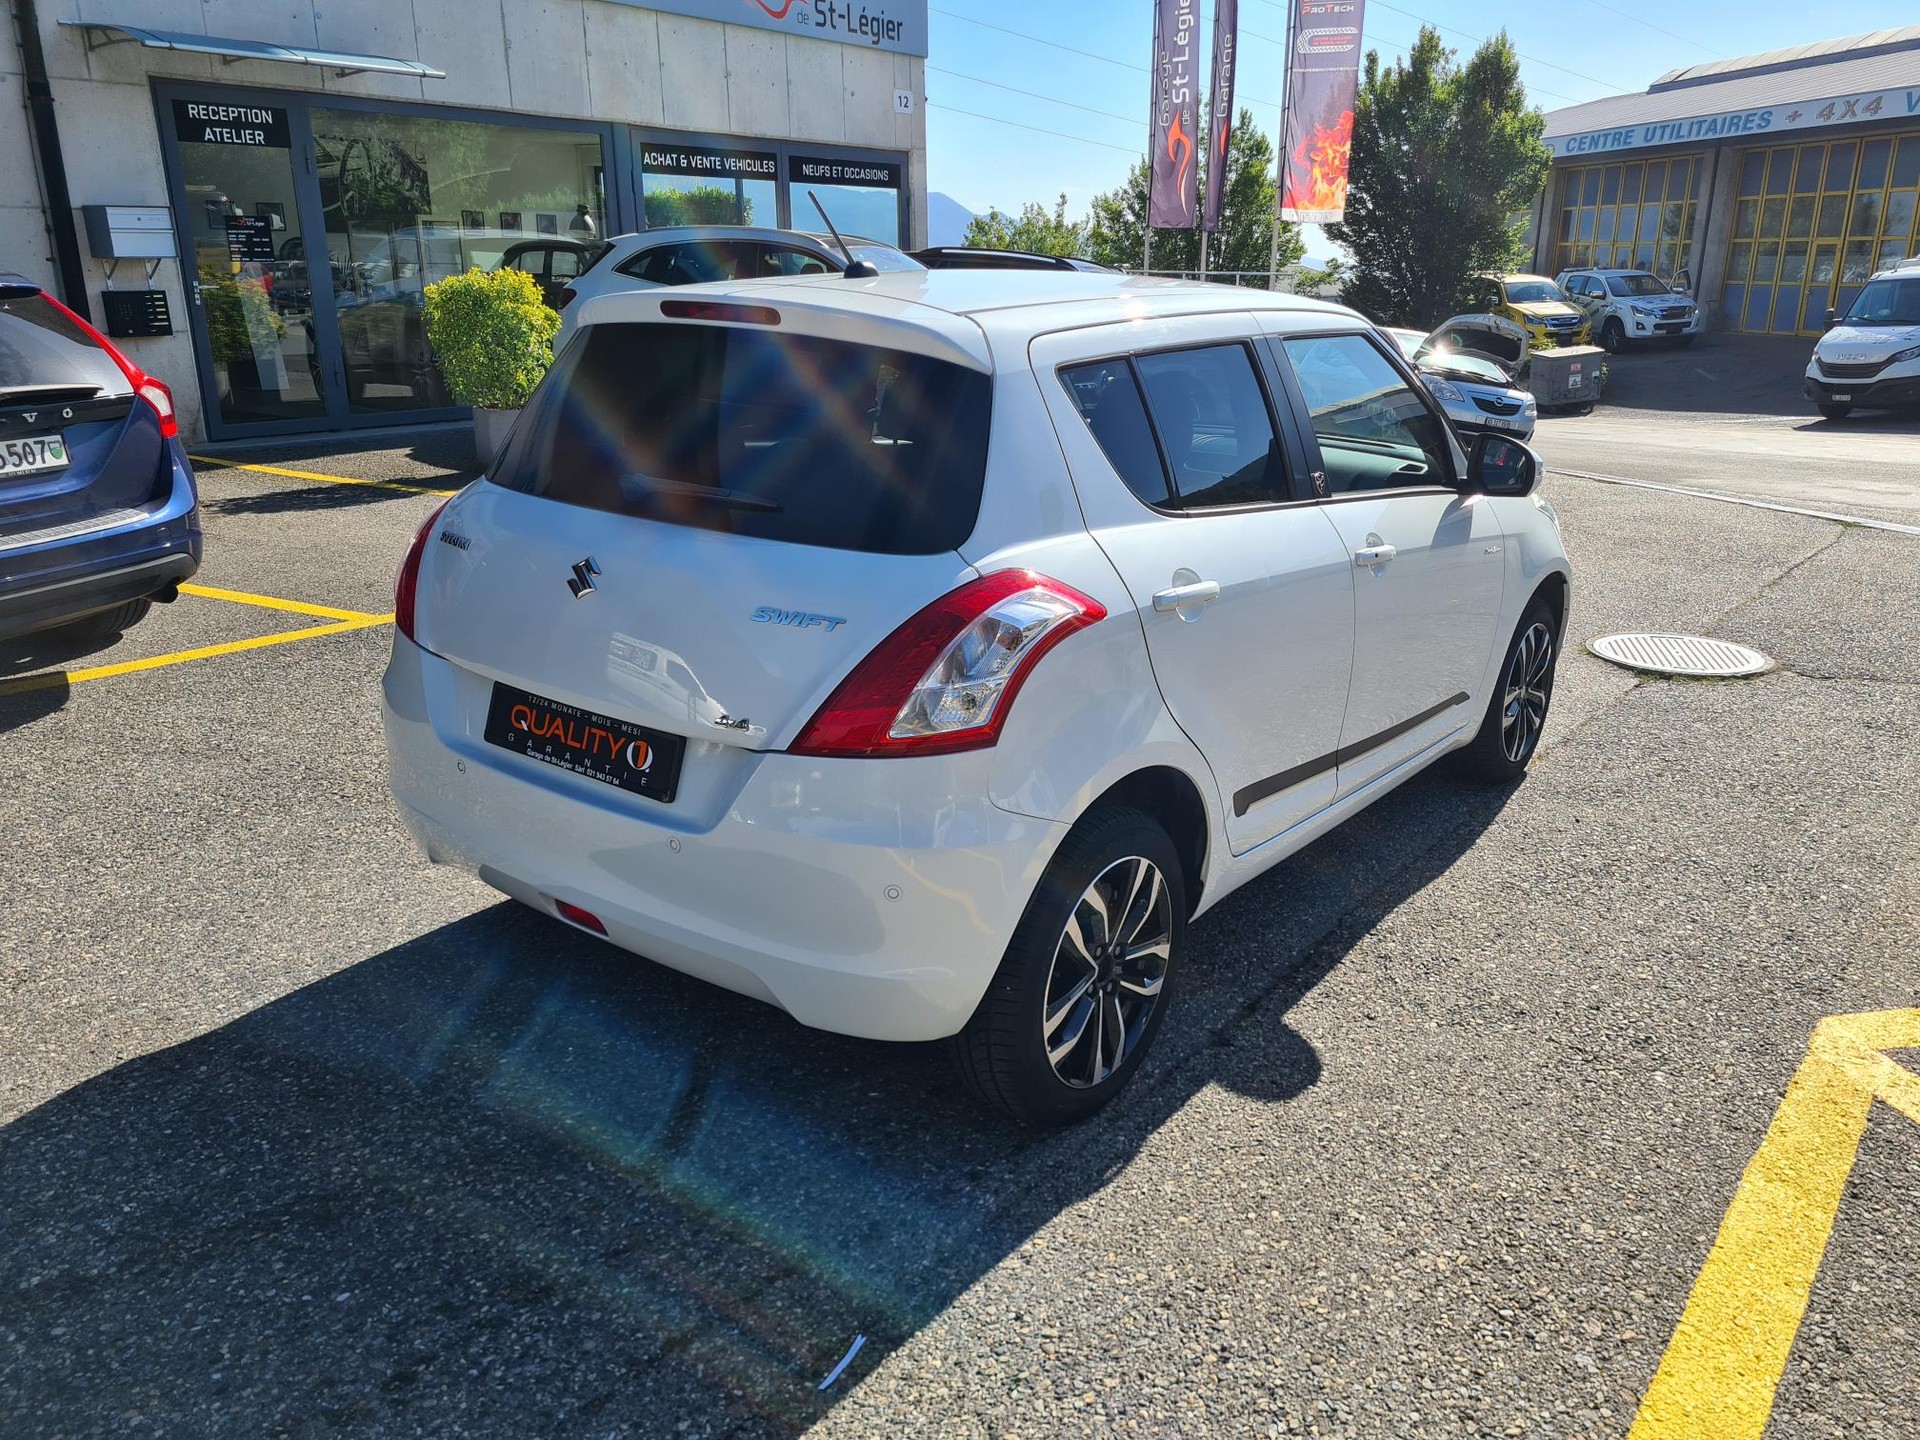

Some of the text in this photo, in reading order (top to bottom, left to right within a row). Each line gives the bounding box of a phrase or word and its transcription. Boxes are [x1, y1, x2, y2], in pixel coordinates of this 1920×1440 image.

[796, 0, 903, 45] de St-Légier
[898, 95, 909, 109] 12
[187, 104, 273, 124] RECEPTION
[204, 127, 266, 145] ATELIER
[1566, 129, 1635, 153] CENTRE
[1643, 110, 1773, 142] UTILITAIRES
[643, 152, 775, 173] ACHAT & VENTE VEHICULES
[802, 163, 889, 181] NEUFS ET OCCASIONS
[750, 607, 848, 632] SWIFT
[528, 695, 548, 706] 12/24
[551, 701, 581, 717] MONATE
[591, 714, 612, 727] MOIS
[621, 723, 641, 736] MESI
[511, 704, 627, 760] QUALITY
[526, 748, 544, 761] Garage
